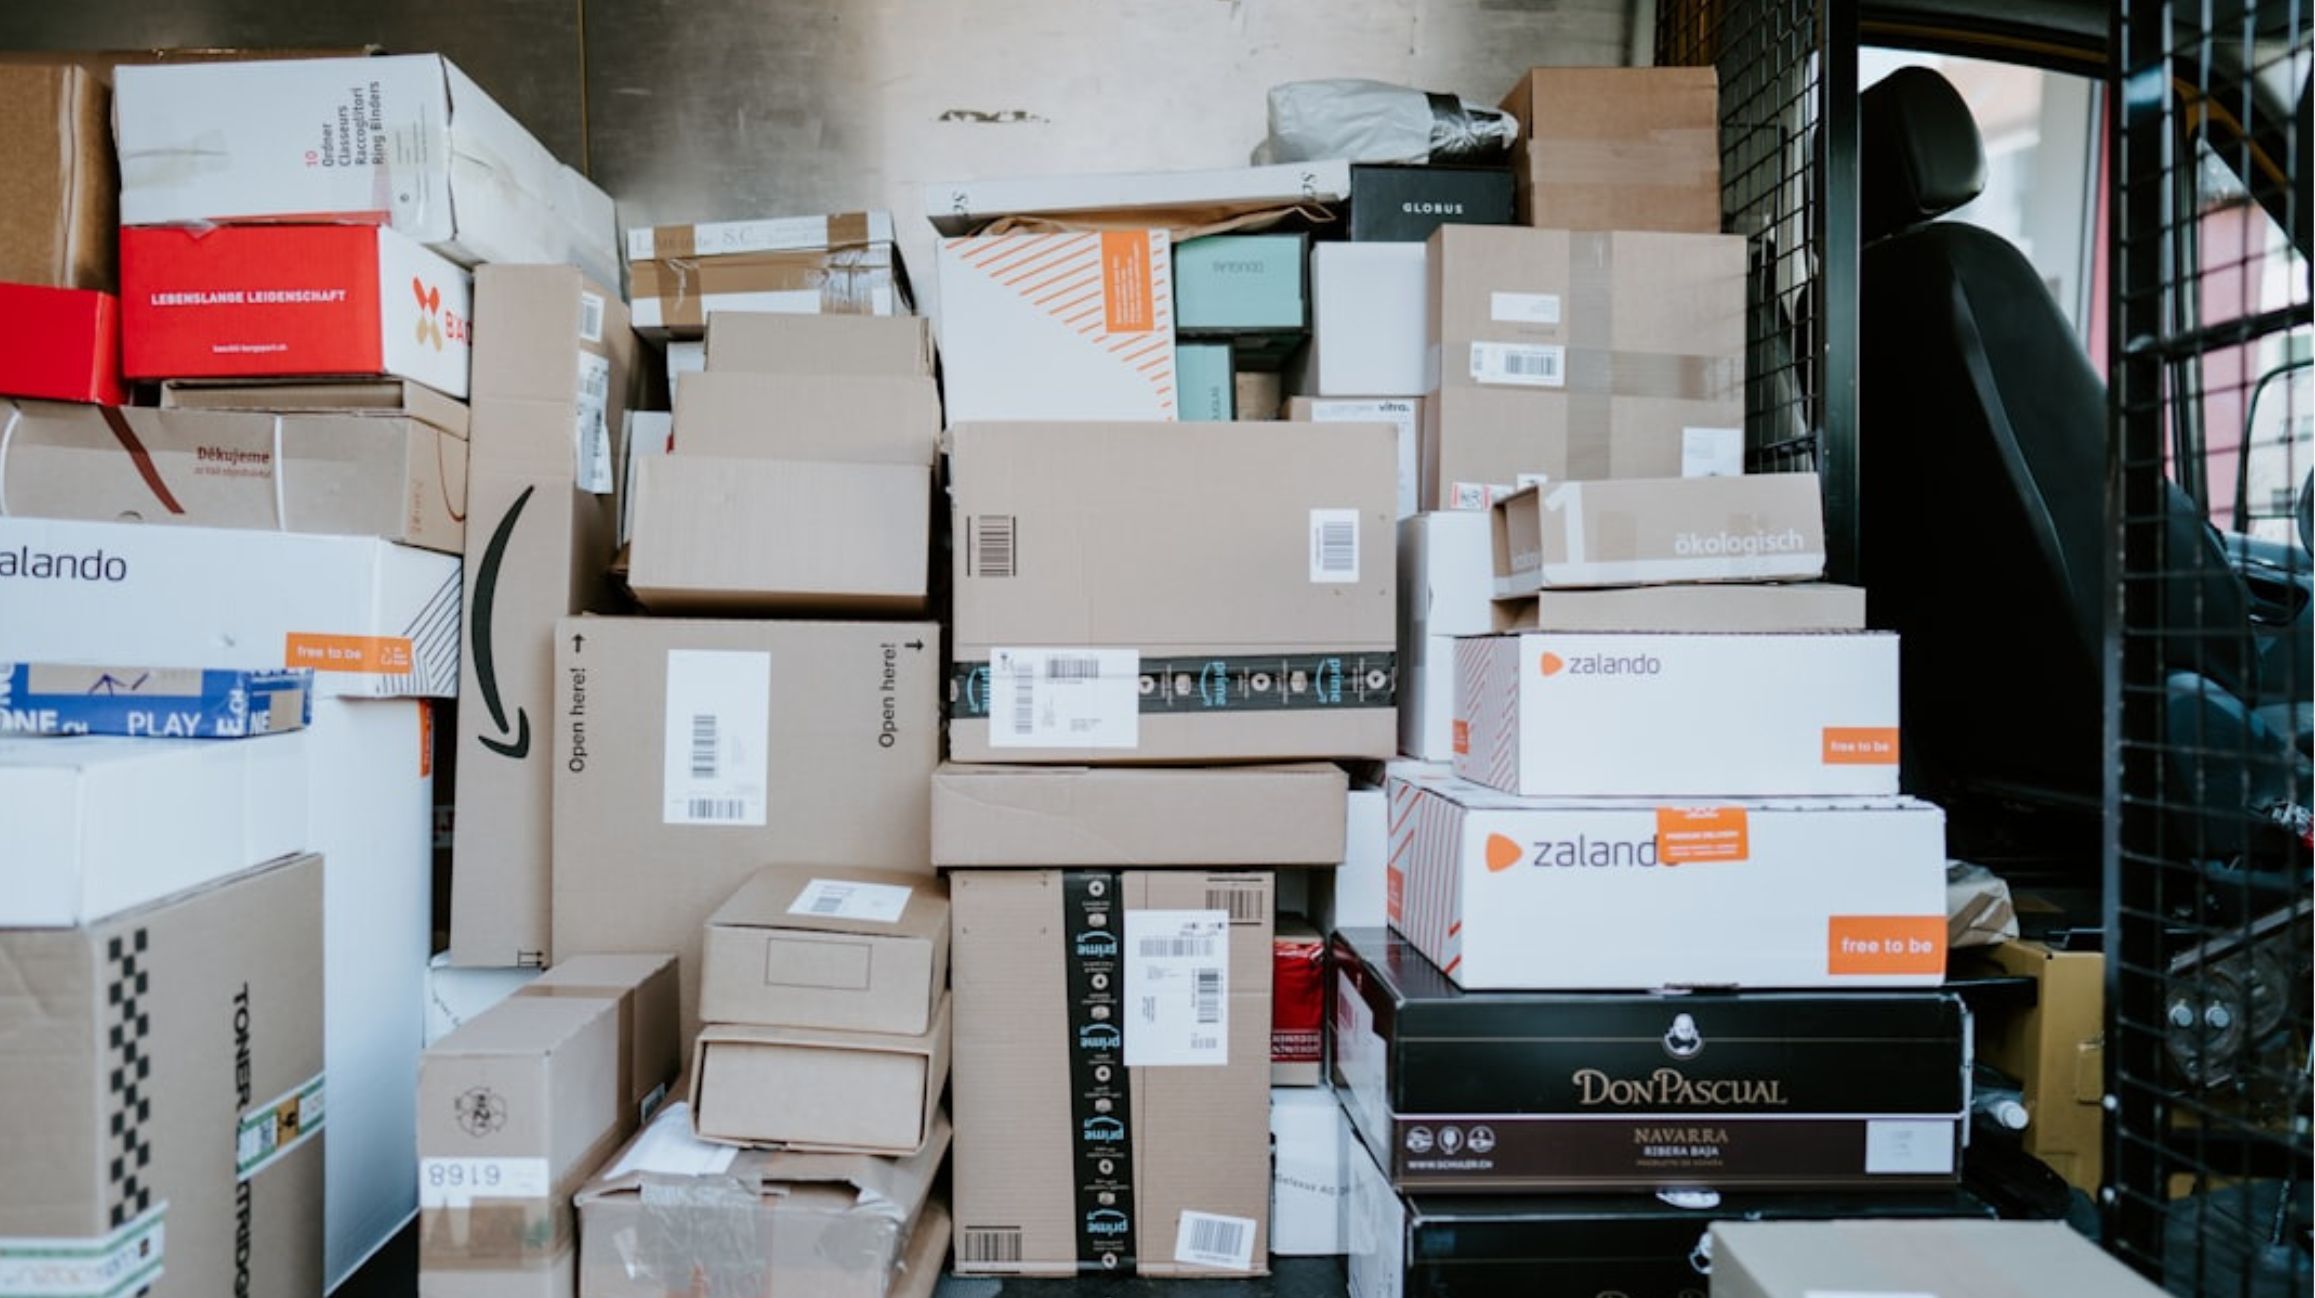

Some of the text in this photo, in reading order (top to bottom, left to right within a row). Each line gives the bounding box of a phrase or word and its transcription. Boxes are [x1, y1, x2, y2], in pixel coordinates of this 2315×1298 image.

[350, 87, 369, 165] Raccoglitori
[370, 80, 386, 165] Ring Binders
[321, 122, 335, 167] Ordner
[337, 104, 351, 167] Classeurs
[304, 150, 318, 167] 10
[1402, 202, 1464, 215] GLOBUS
[151, 289, 347, 305] LEBENSLANGE LEIDENSCHAFT
[197, 447, 270, 466] Děkujeme
[1674, 528, 1805, 557] ökologisch
[0, 546, 128, 582] alando
[1569, 653, 1660, 675] zalando
[1212, 661, 1229, 706] prime
[1326, 657, 1344, 702] prime
[879, 643, 898, 748] Open here!
[127, 711, 201, 736] PLAY
[569, 668, 588, 772] Open here!
[1831, 740, 1890, 752] free to be
[1533, 834, 1679, 867] zaland
[1077, 941, 1117, 957] prime
[1841, 937, 1932, 953] free to be
[233, 982, 249, 1110] TONER
[1080, 1034, 1120, 1050] prime
[1083, 1127, 1124, 1142] prime
[1634, 1128, 1728, 1143] NAVARRA
[1643, 1146, 1719, 1157] RIBERA BAJA
[1087, 1220, 1128, 1236] prime
